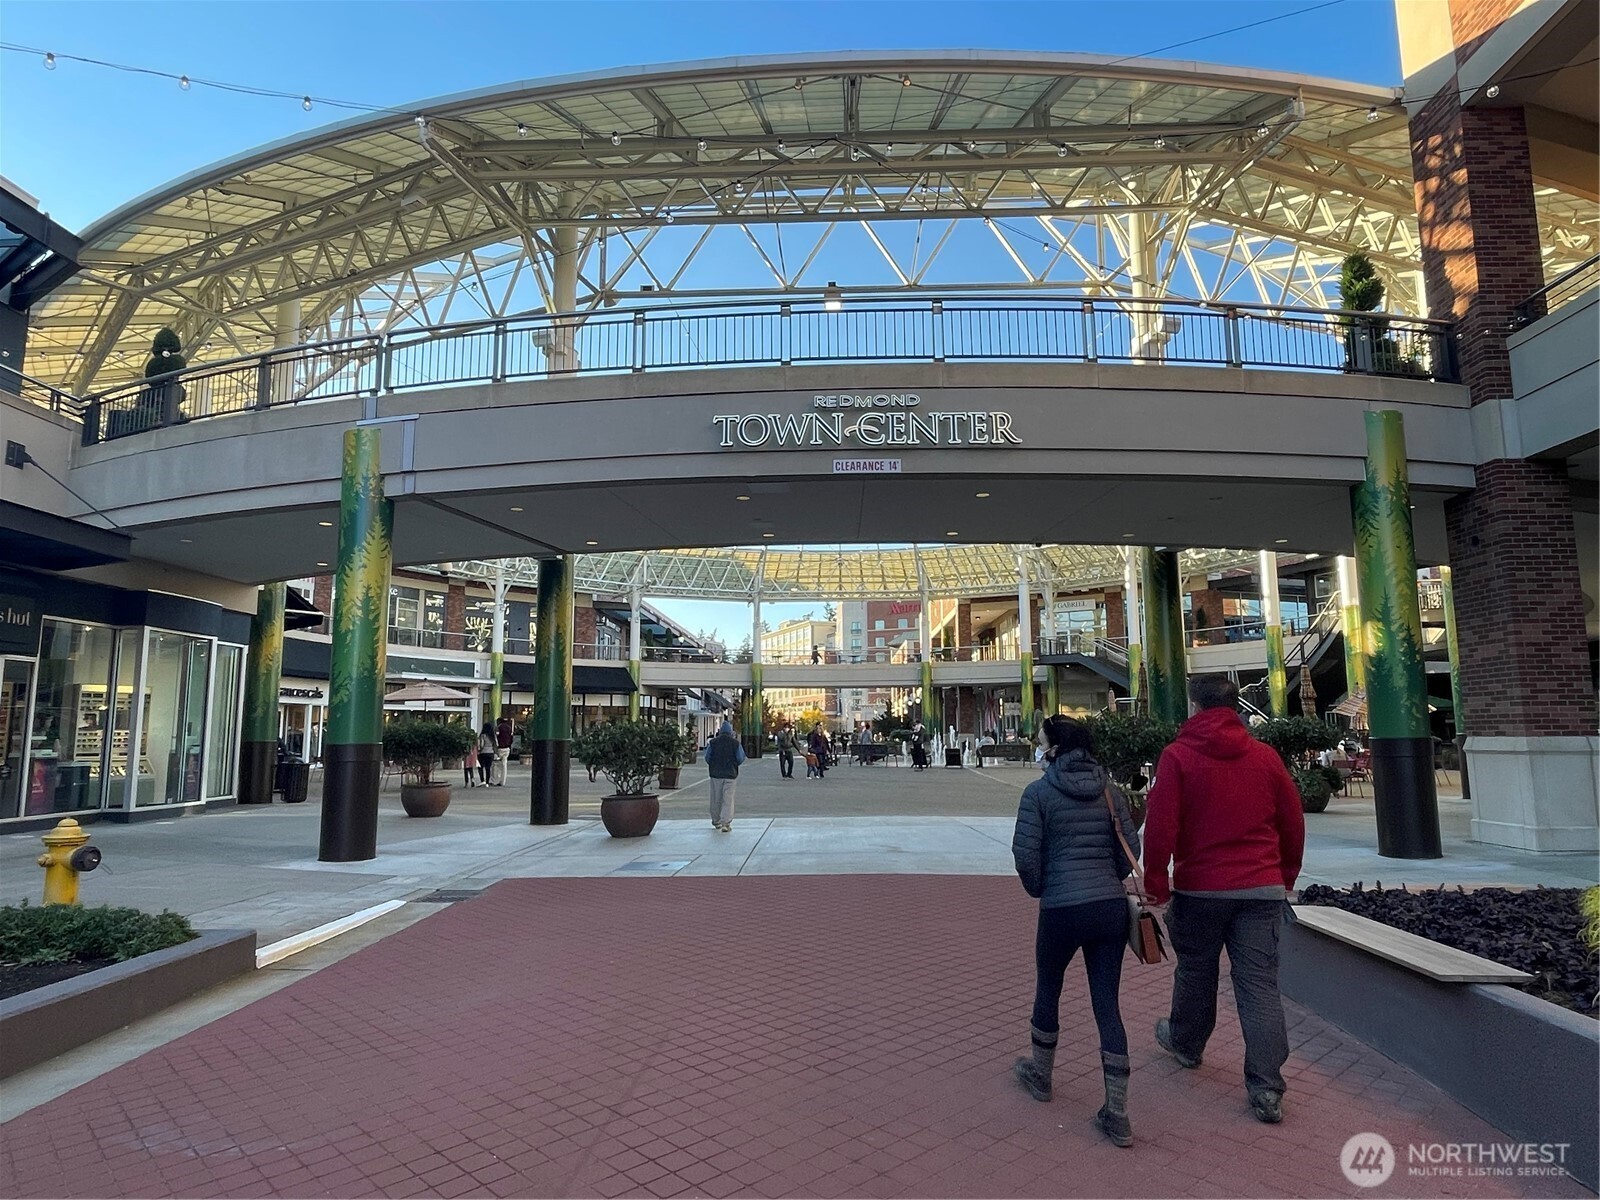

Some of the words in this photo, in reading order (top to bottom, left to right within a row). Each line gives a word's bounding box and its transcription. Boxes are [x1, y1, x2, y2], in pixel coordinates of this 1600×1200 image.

[813, 393, 921, 408] REDMOND
[712, 412, 844, 447] TOWN
[856, 411, 1023, 446] CENTER
[835, 461, 885, 471] CLEARANCE
[1057, 600, 1088, 609] GABRIEL
